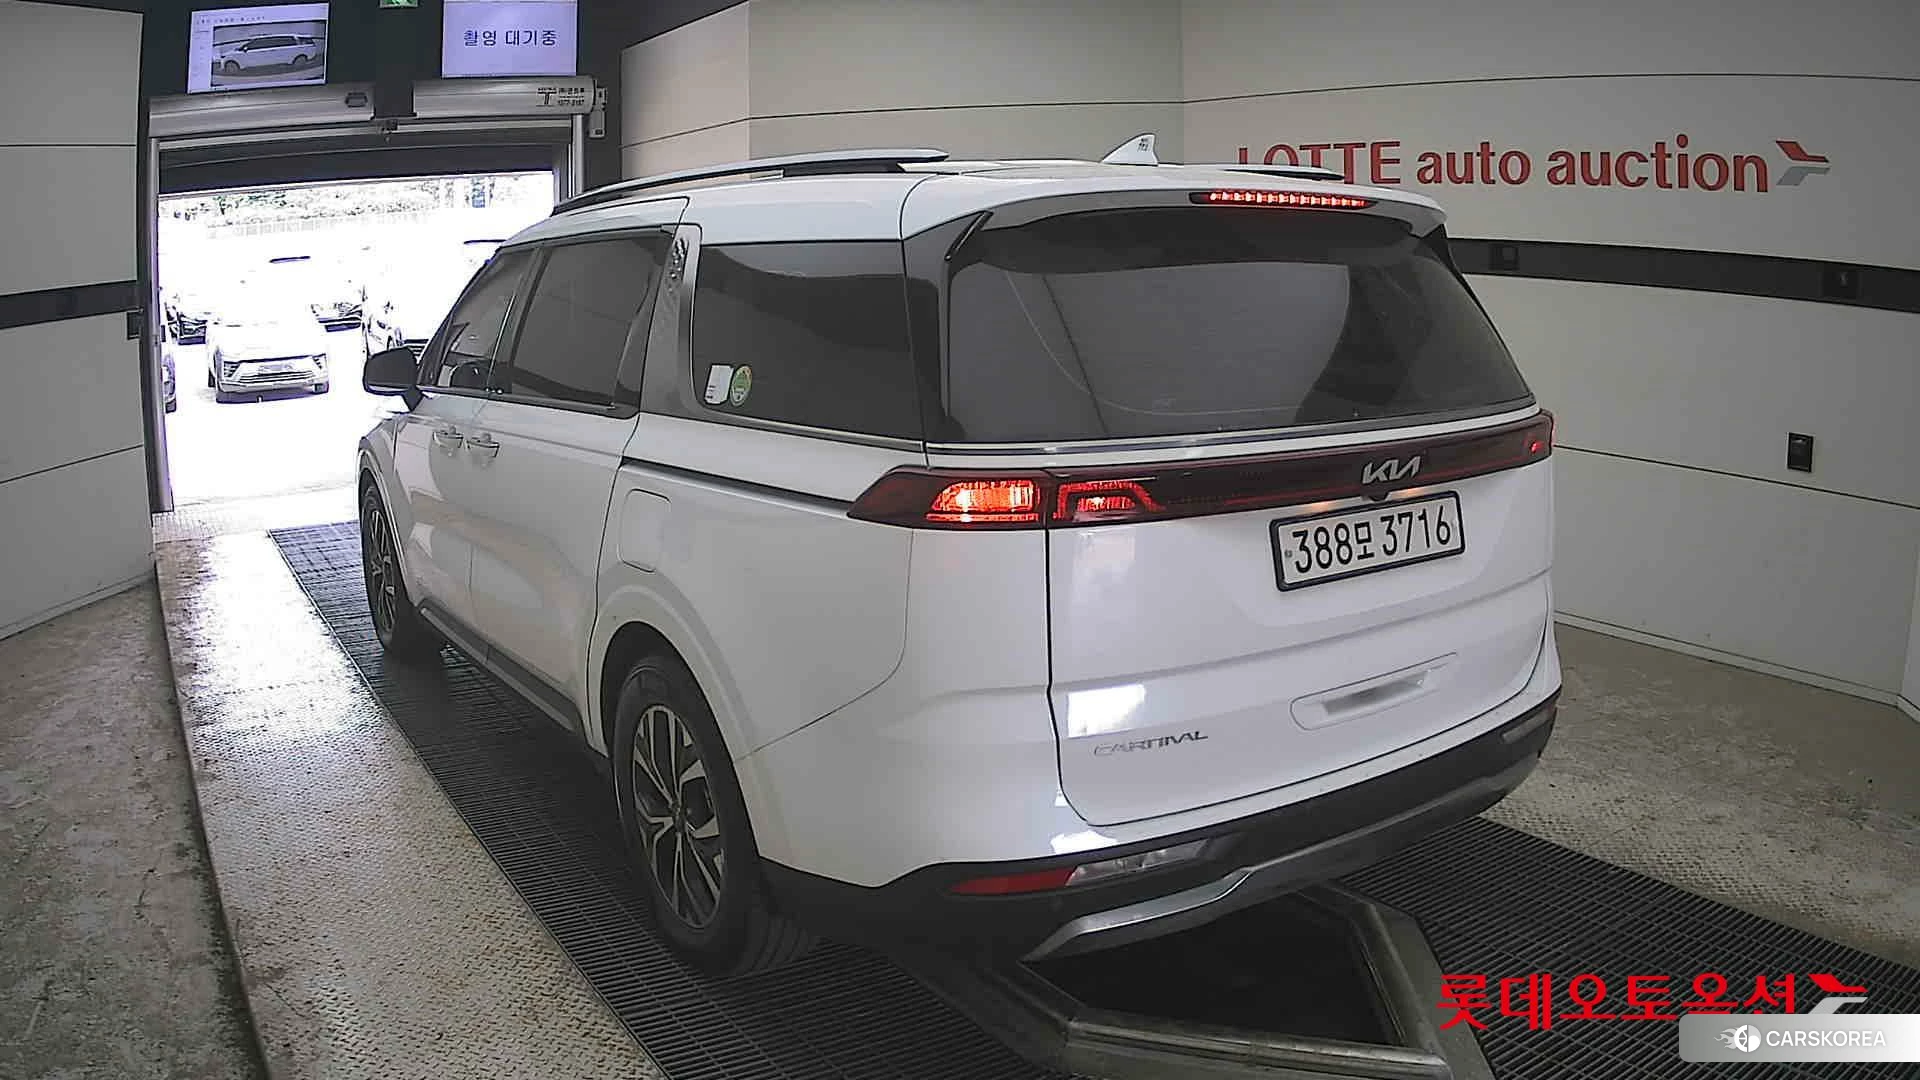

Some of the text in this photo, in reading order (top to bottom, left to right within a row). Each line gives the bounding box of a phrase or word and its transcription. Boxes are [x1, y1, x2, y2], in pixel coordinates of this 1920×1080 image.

[505, 29, 557, 47] 대기중
[1416, 140, 1531, 186] auto
[1546, 133, 1768, 193] auction
[1380, 504, 1452, 556] 3716
